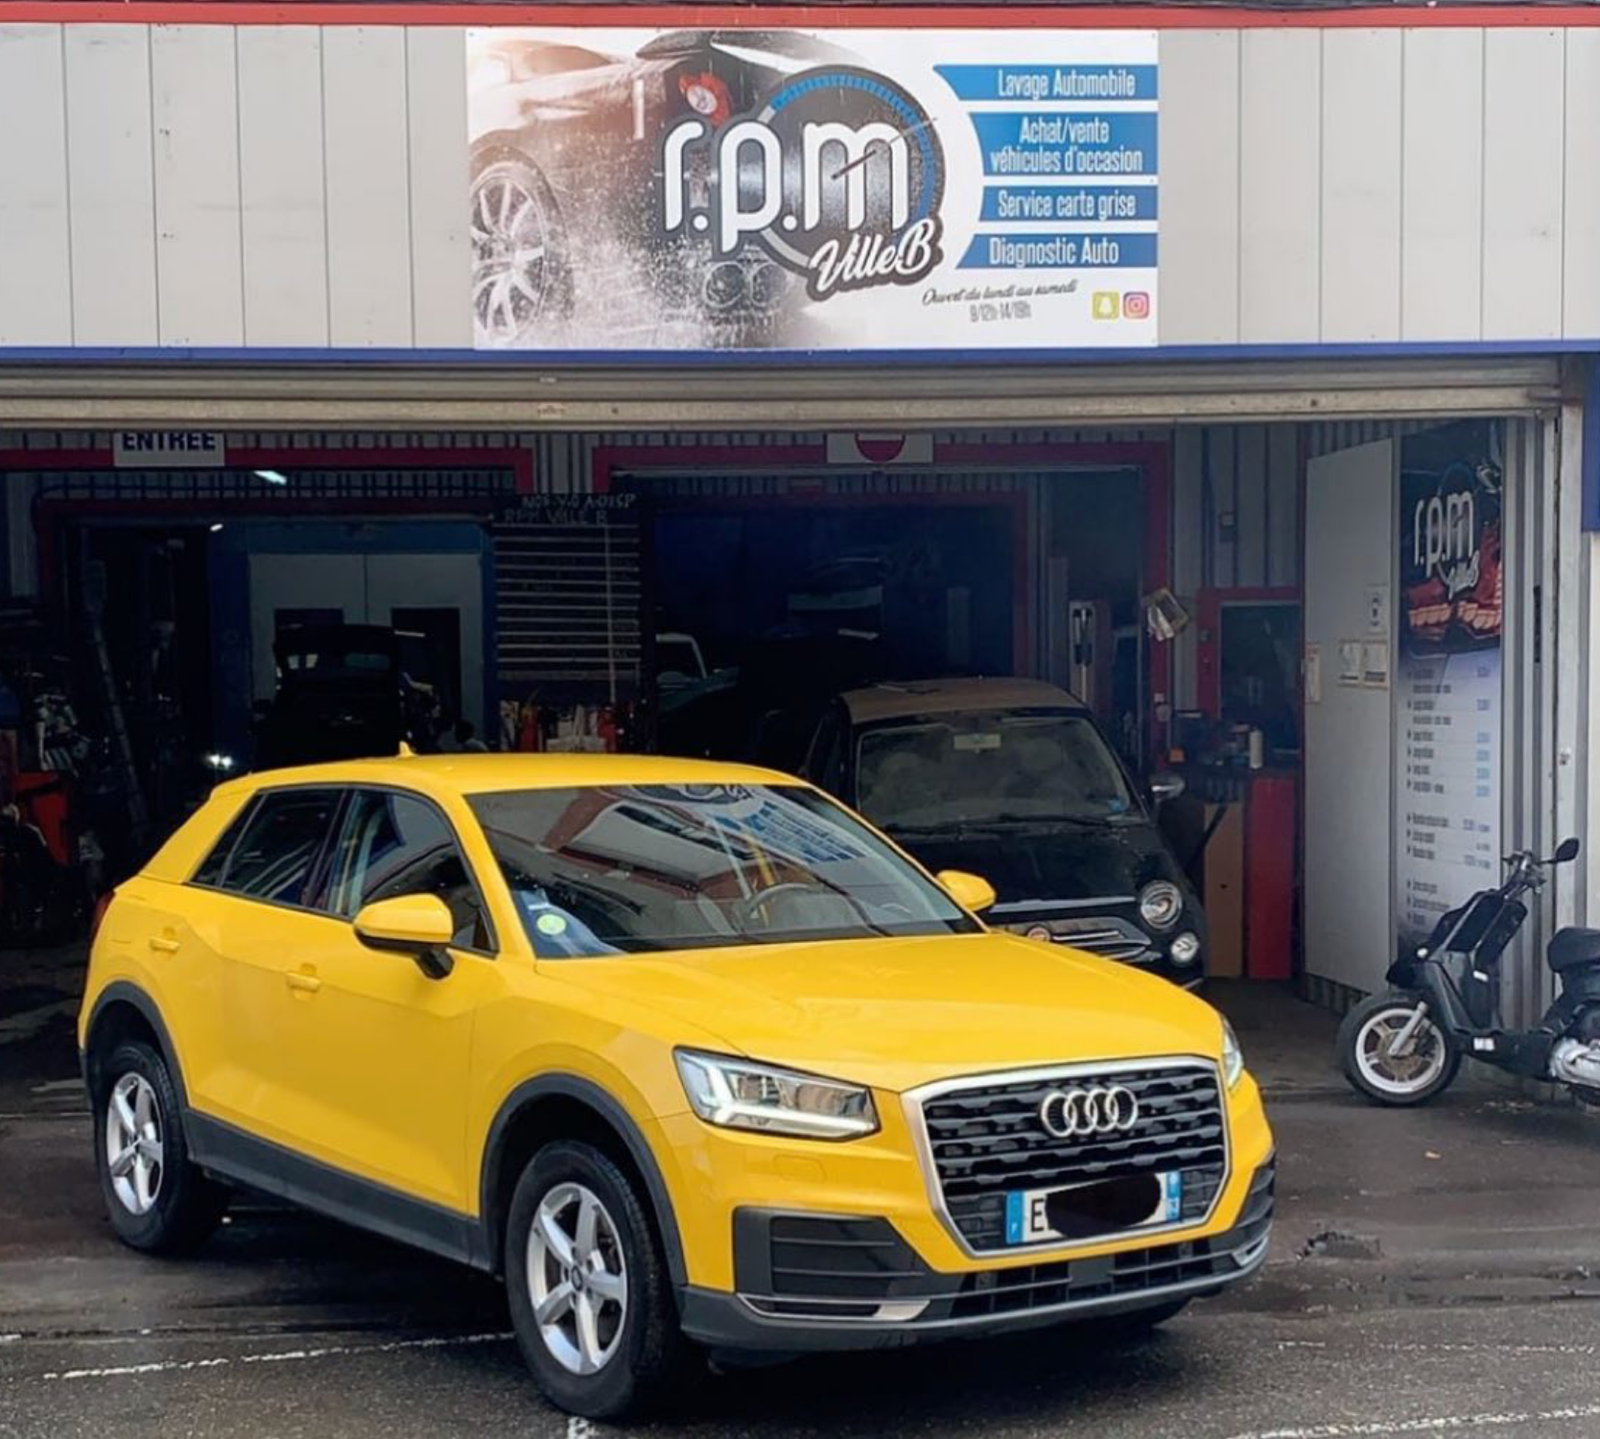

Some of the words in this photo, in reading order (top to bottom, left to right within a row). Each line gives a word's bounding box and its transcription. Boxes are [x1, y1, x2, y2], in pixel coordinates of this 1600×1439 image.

[998, 69, 1049, 100] Lavage
[1053, 69, 1136, 96] Automobile
[1019, 116, 1109, 143] Achat/vente
[990, 146, 1061, 173] véhicules
[1064, 146, 1143, 173] d'occasion
[664, 121, 909, 253] r.p.m
[998, 190, 1052, 217] Service
[1056, 192, 1095, 217] carte
[1099, 190, 1136, 221] grise
[989, 237, 1076, 269] Diagnostic
[1081, 237, 1119, 264] Auto
